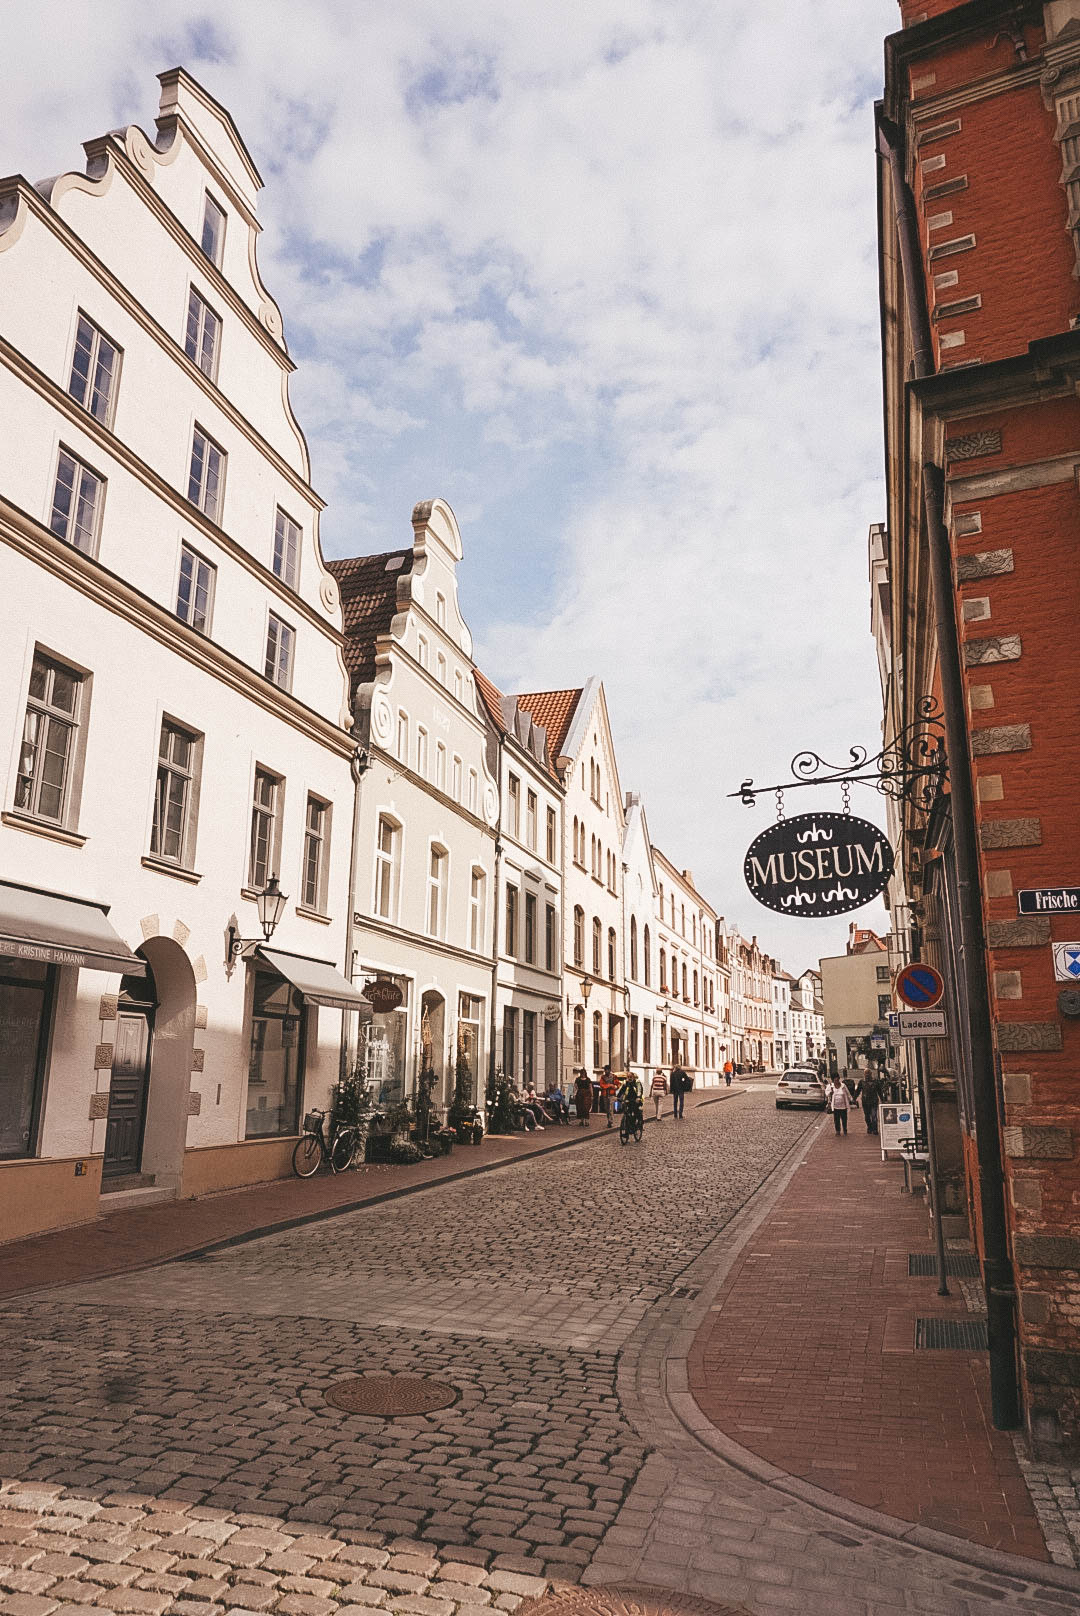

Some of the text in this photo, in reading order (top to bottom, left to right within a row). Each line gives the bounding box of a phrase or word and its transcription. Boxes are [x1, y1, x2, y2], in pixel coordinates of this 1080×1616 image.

[750, 841, 884, 887] MUSEUM
[1035, 890, 1078, 910] Frische
[18, 945, 51, 960] KRISTINE
[53, 951, 85, 965] HAMANN
[901, 1020, 943, 1029] Ladezone
